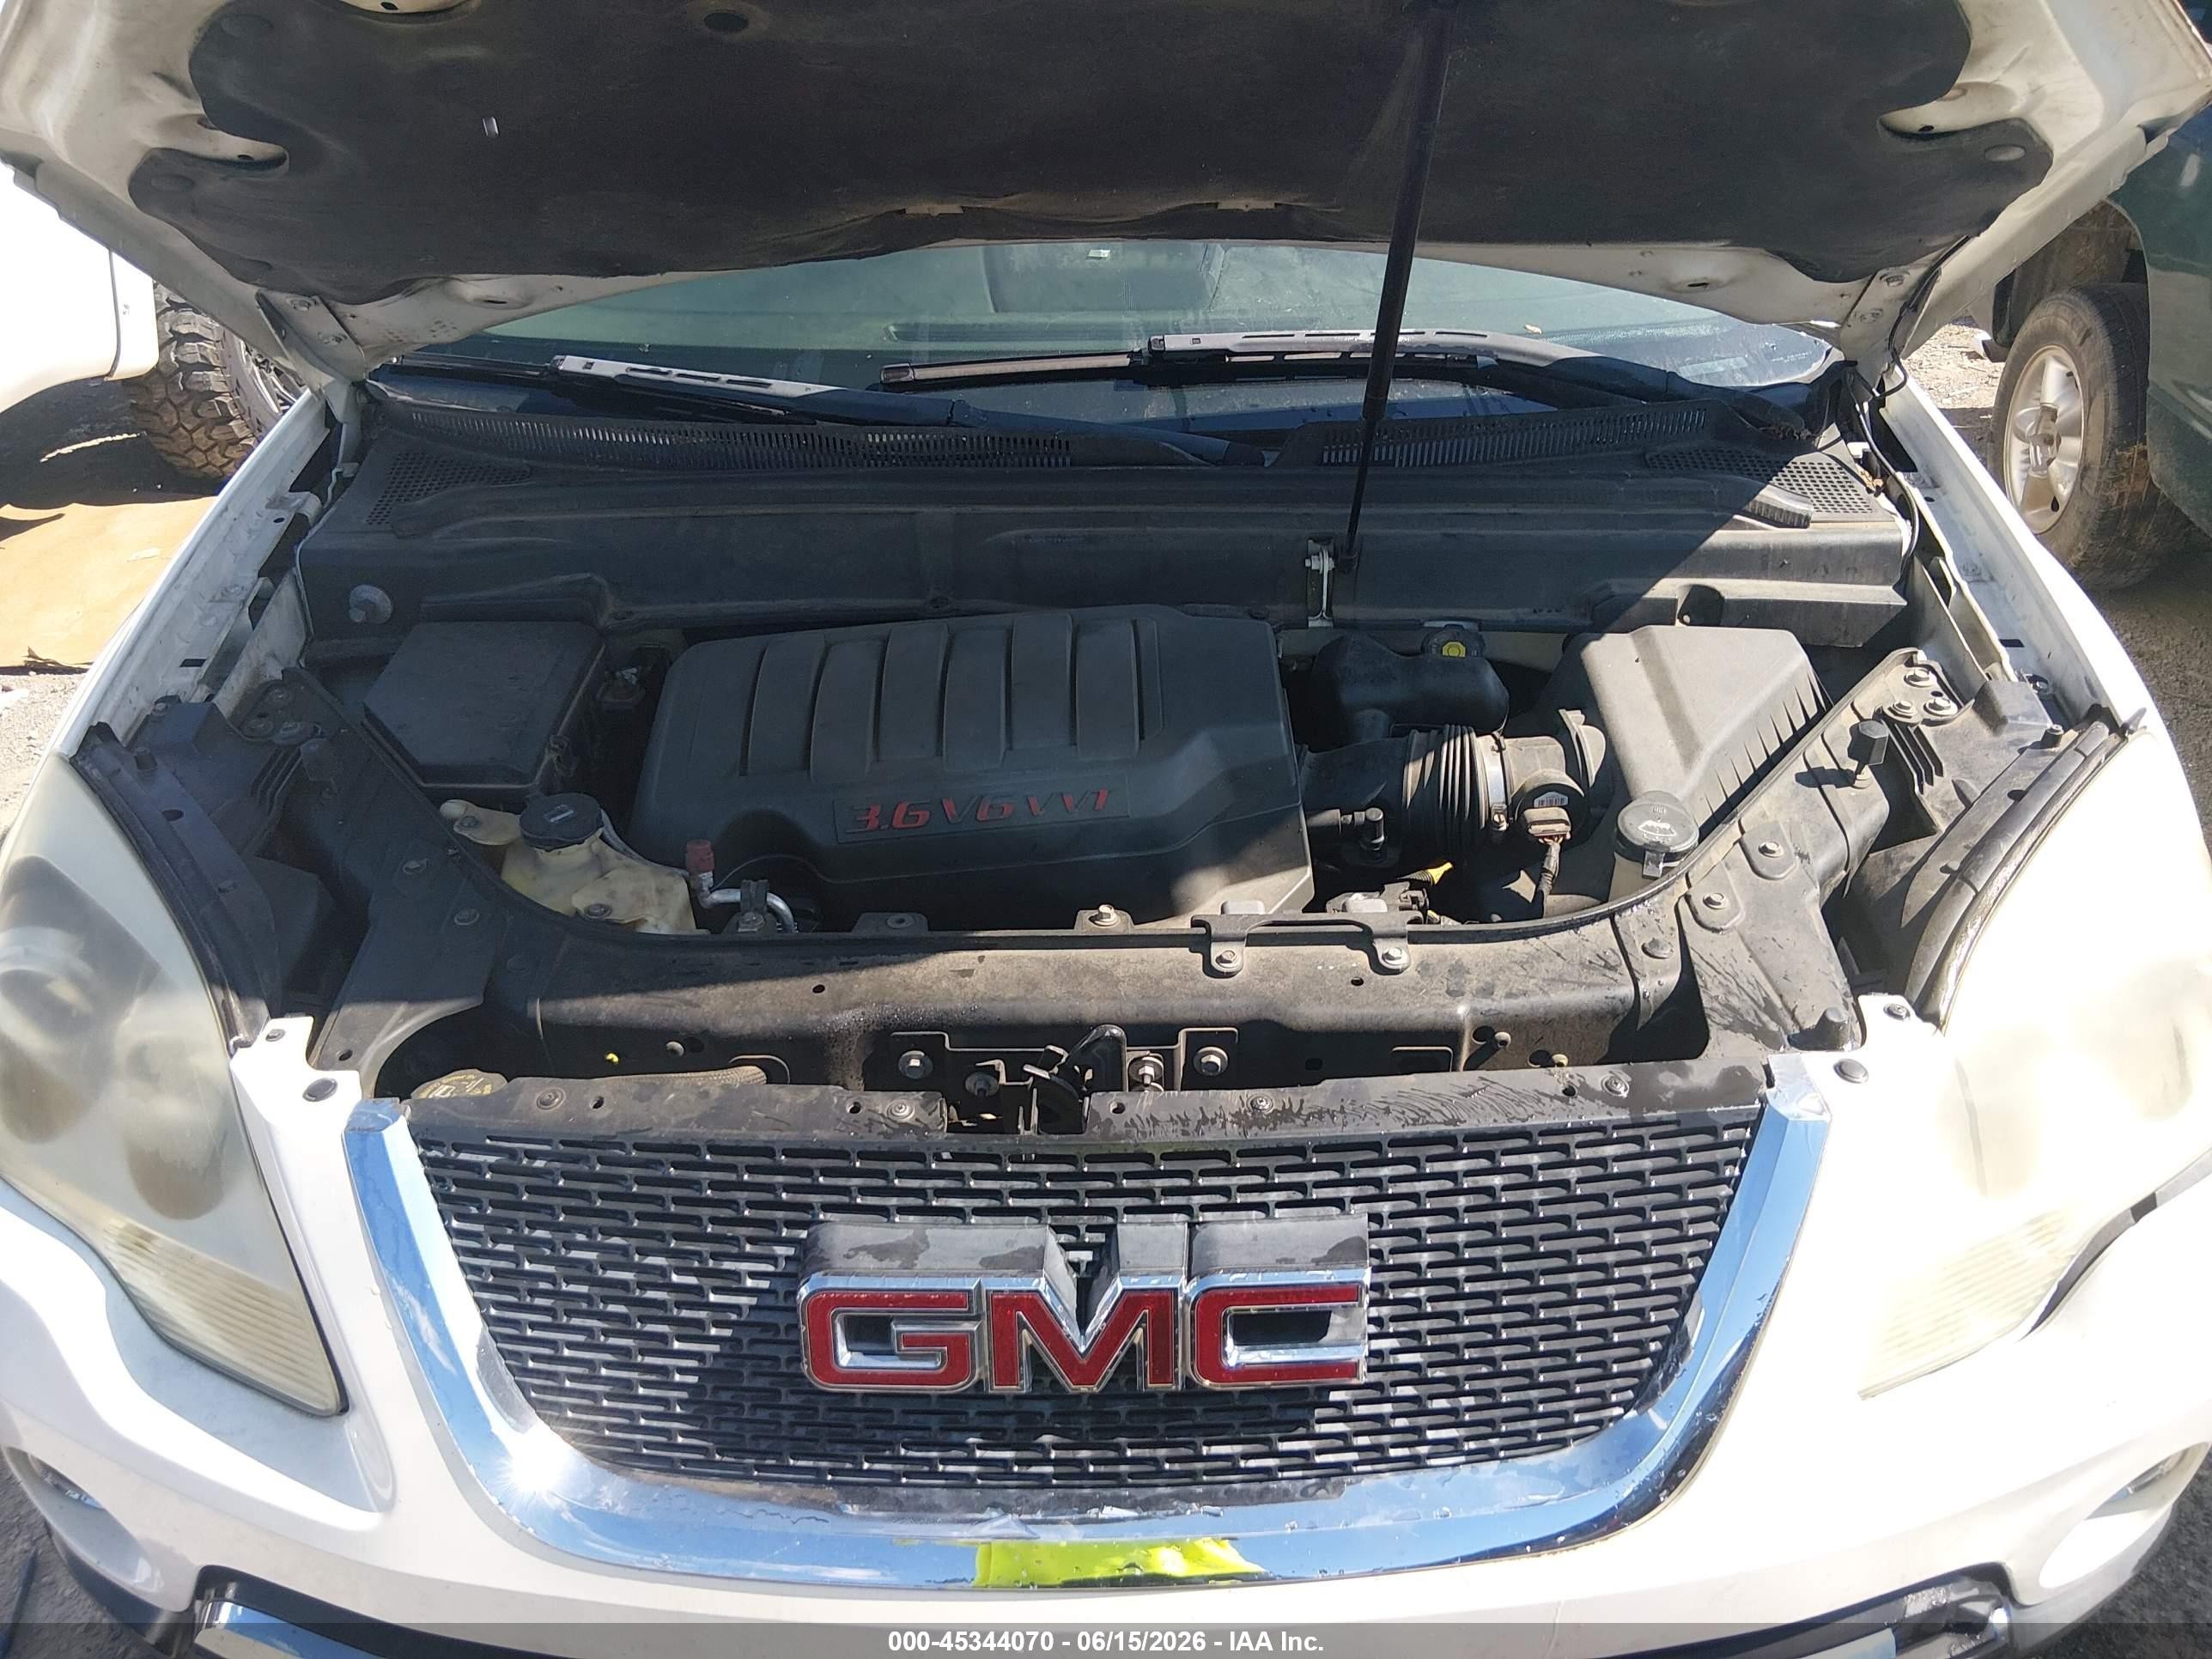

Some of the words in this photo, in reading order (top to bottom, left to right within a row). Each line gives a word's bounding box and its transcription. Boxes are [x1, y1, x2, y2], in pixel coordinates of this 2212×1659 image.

[845, 800, 932, 834] 3.6
[939, 792, 1018, 824] V6
[798, 1266, 1372, 1393] GMC
